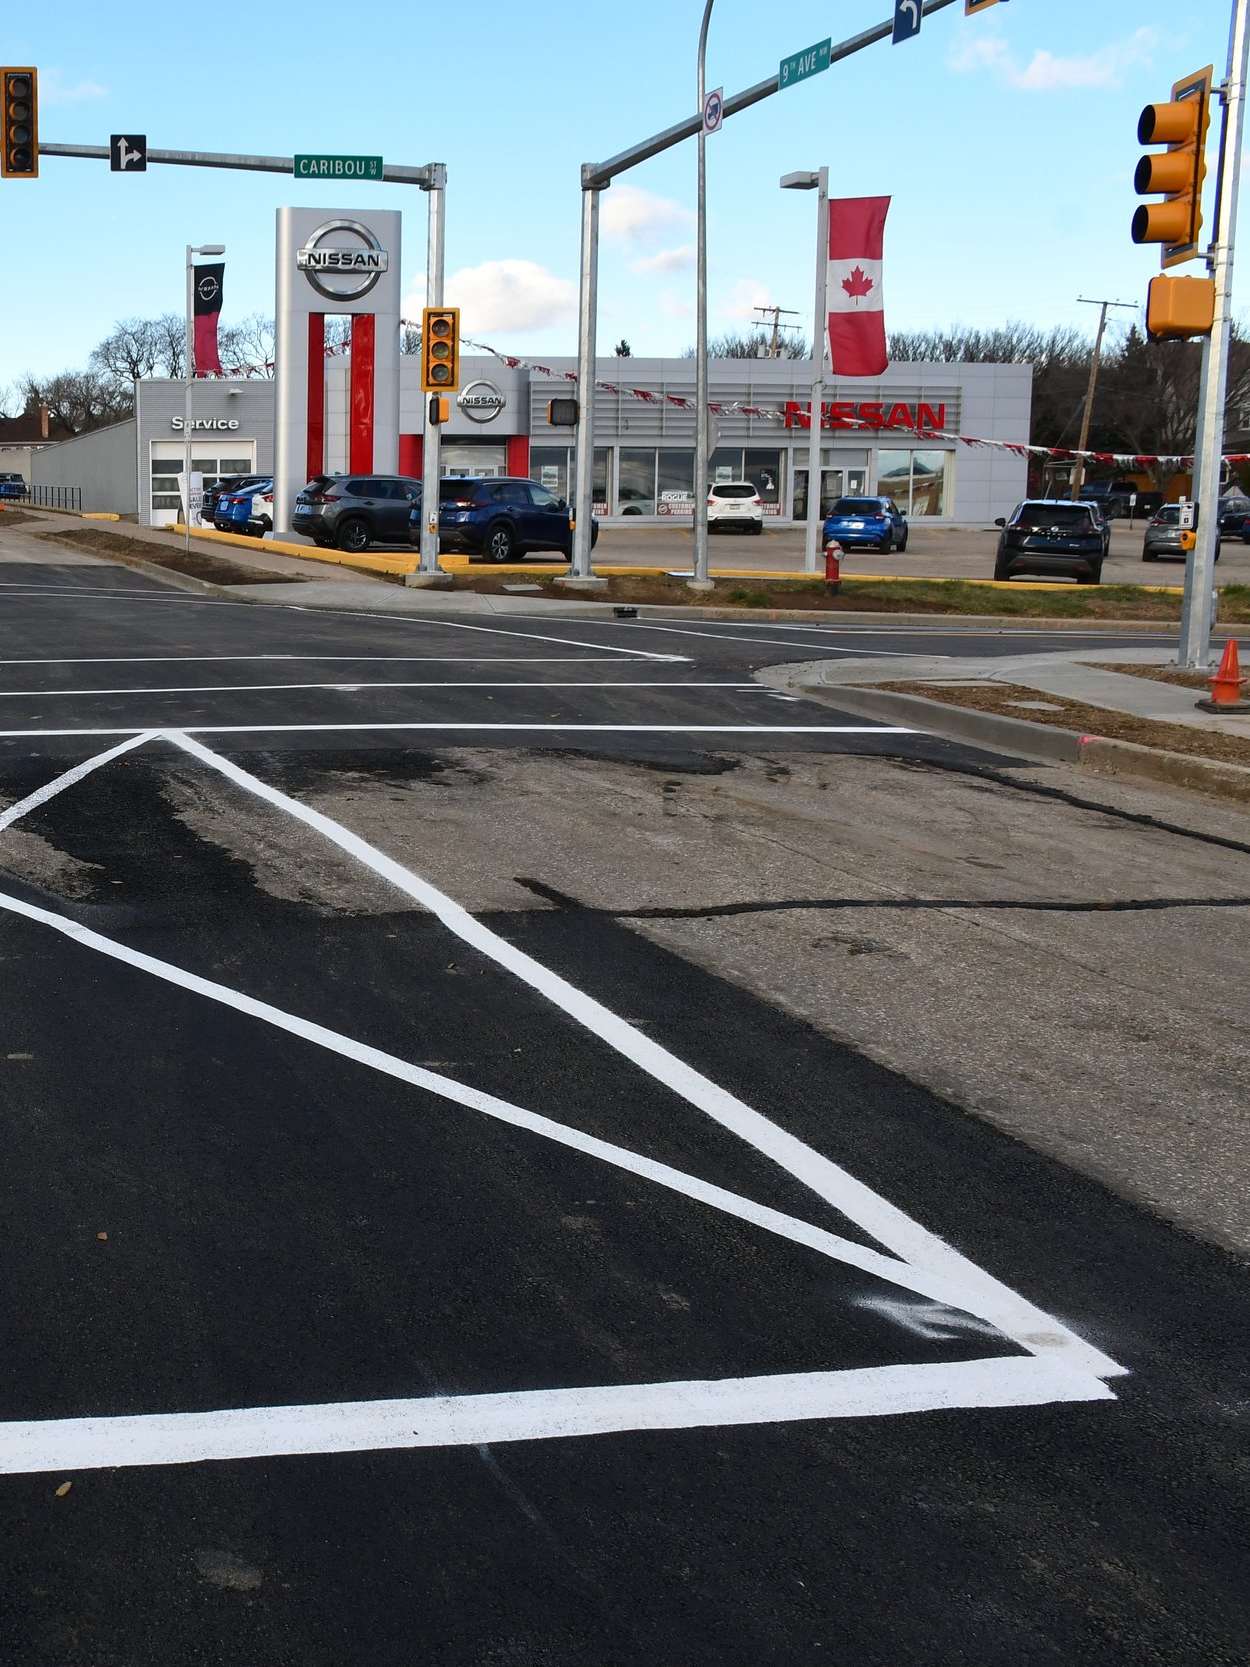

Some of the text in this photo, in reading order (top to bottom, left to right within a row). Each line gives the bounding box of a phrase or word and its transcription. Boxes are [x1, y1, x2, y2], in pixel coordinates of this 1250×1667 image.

[797, 50, 817, 76] AVE
[299, 159, 366, 175] CARIBOU
[307, 252, 380, 267] NISSAN
[462, 396, 502, 405] NISSAN
